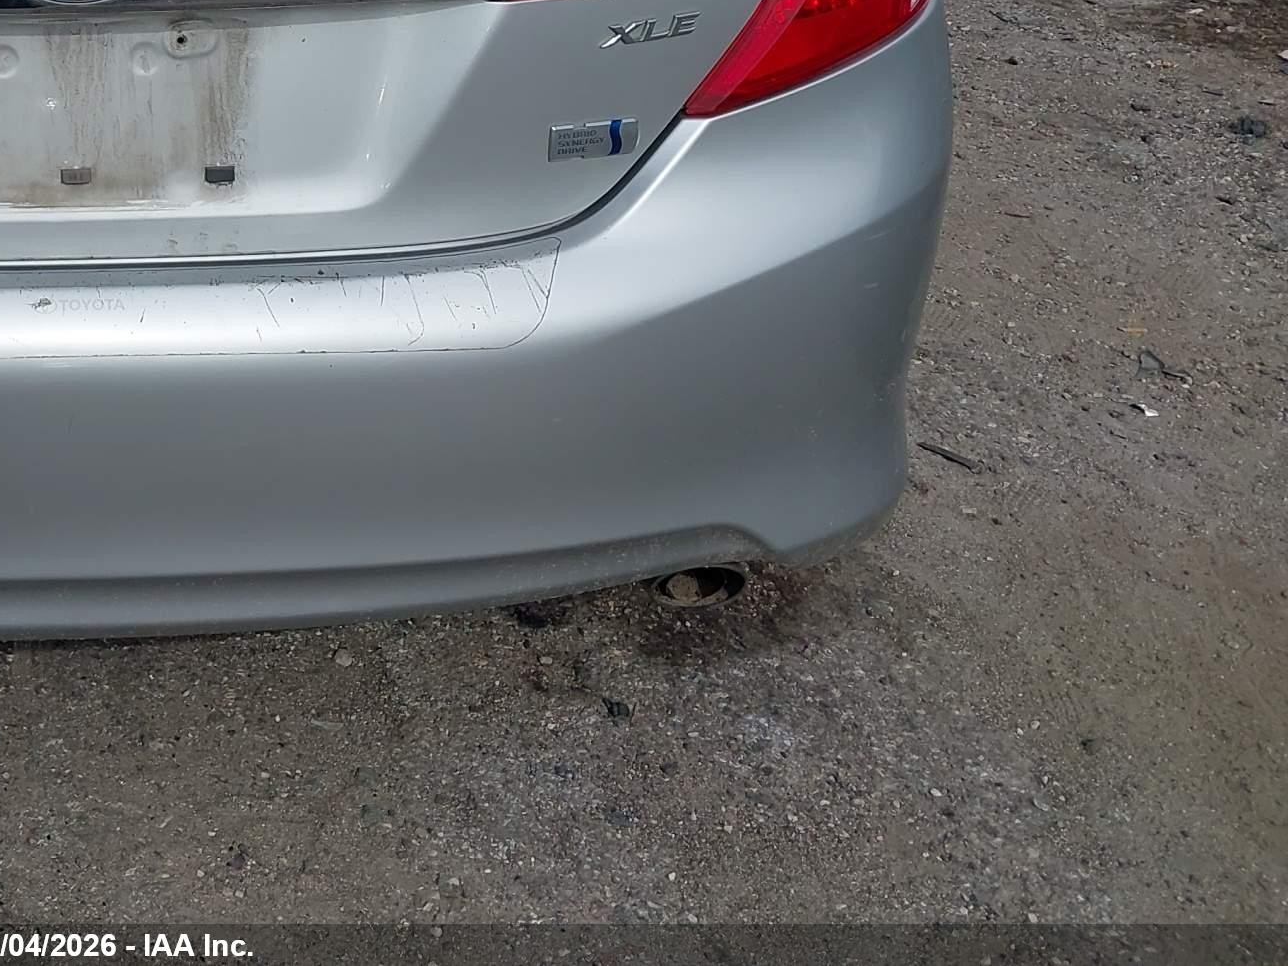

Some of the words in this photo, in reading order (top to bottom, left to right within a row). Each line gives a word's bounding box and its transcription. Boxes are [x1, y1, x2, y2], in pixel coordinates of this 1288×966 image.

[599, 10, 703, 50] XLE
[558, 129, 597, 139] HYBRID
[558, 137, 605, 147] SYNERGY
[557, 145, 588, 155] DRIVE
[59, 298, 125, 312] TOYOTA
